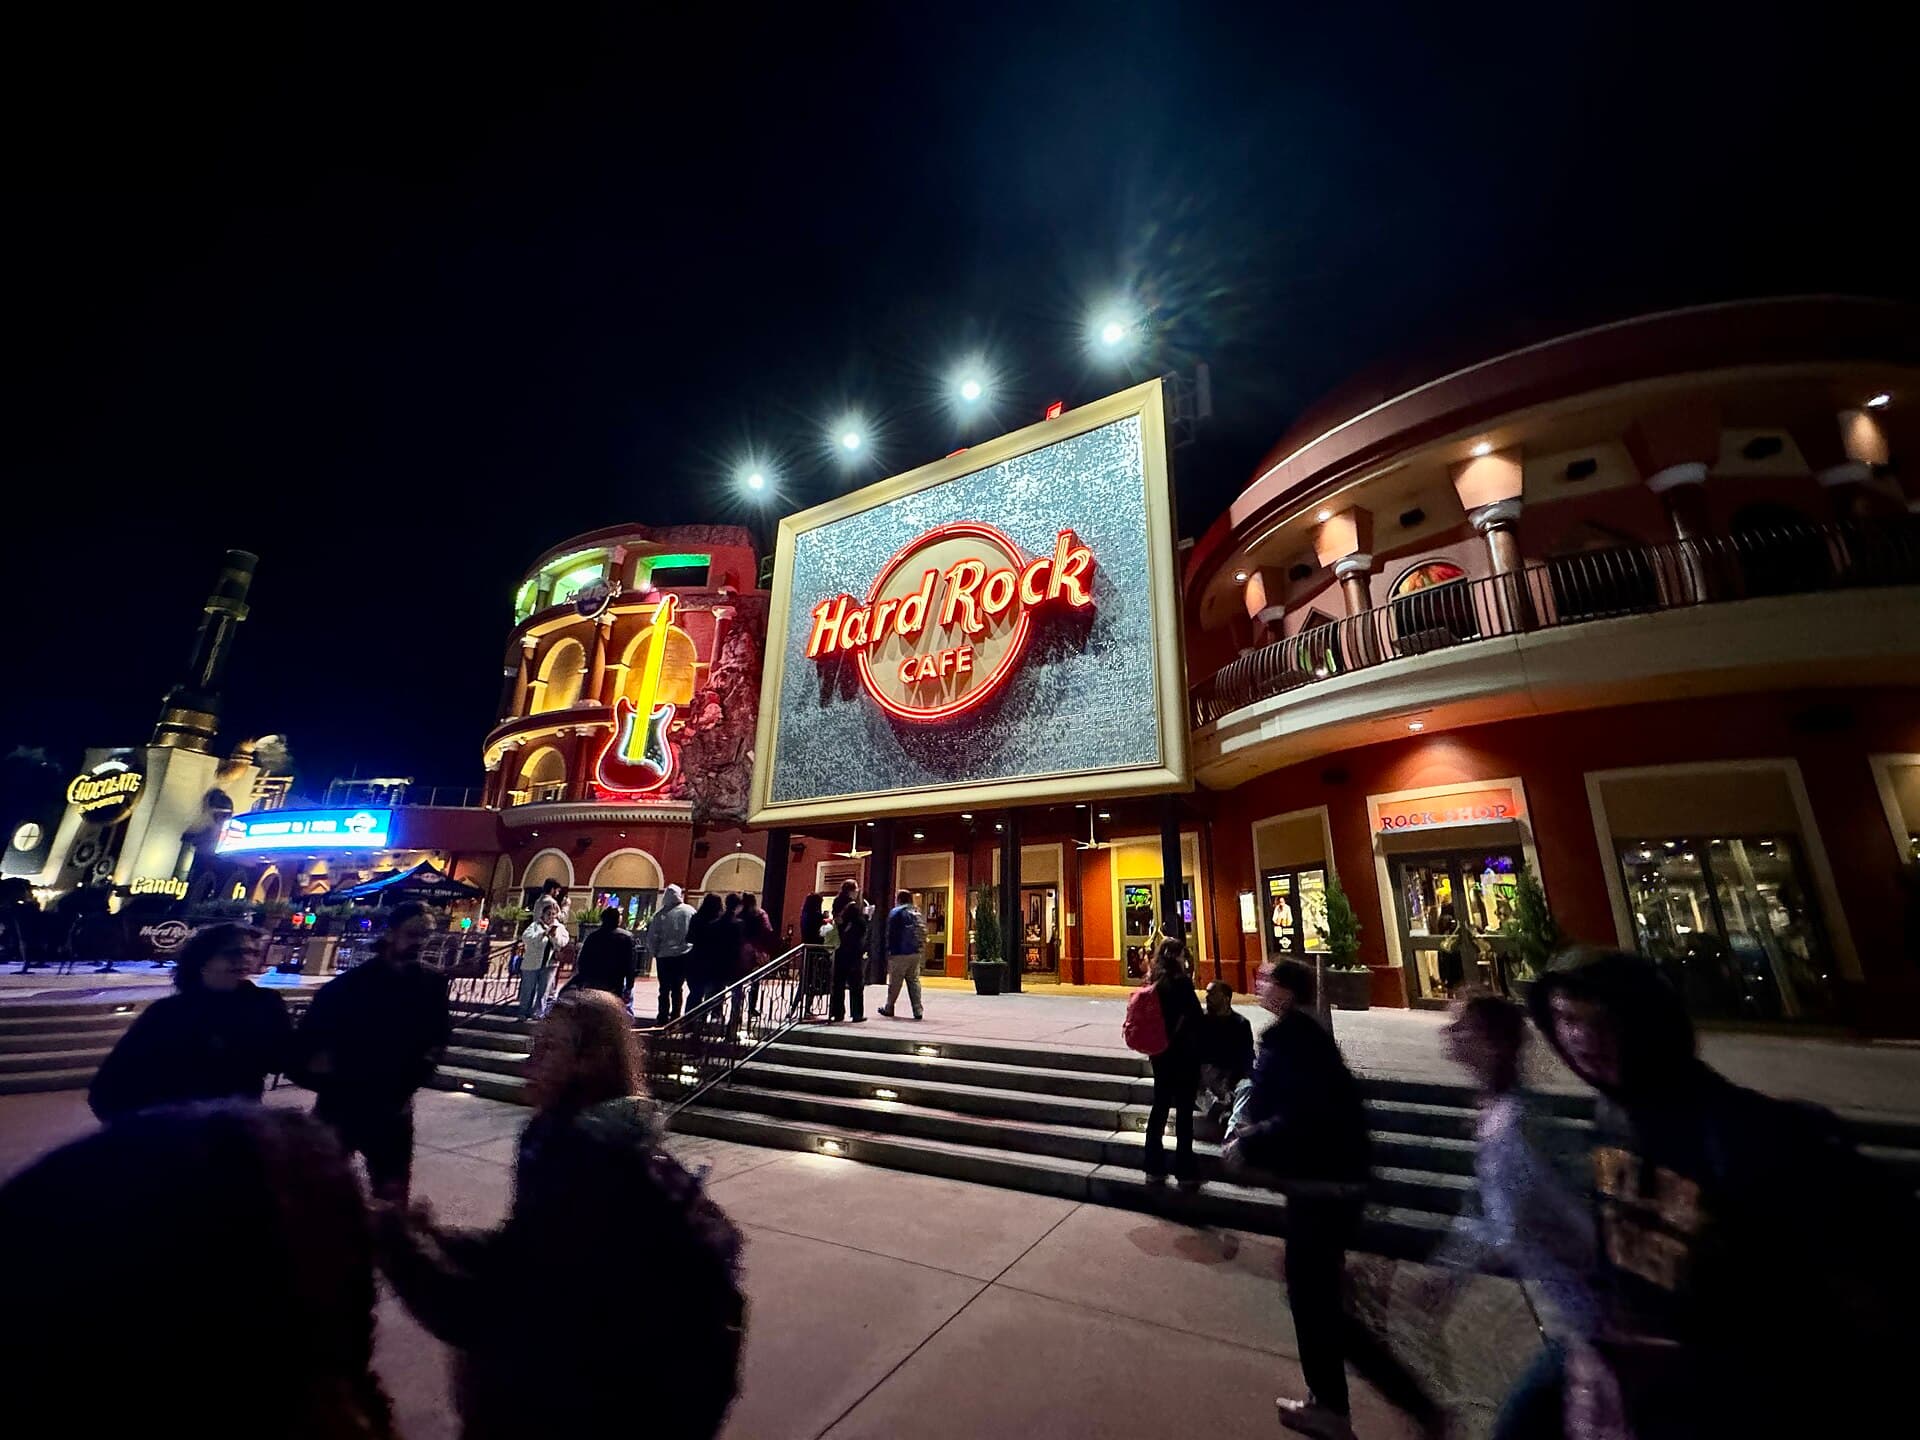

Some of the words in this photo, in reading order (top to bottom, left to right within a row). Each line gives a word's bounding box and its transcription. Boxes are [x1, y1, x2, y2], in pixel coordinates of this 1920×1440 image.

[806, 569, 940, 660] Hard
[940, 528, 1096, 634] Rock
[1380, 811, 1437, 830] ROCK
[1445, 804, 1508, 821] SHOP
[130, 877, 189, 900] Candy
[139, 925, 171, 937] Hard
